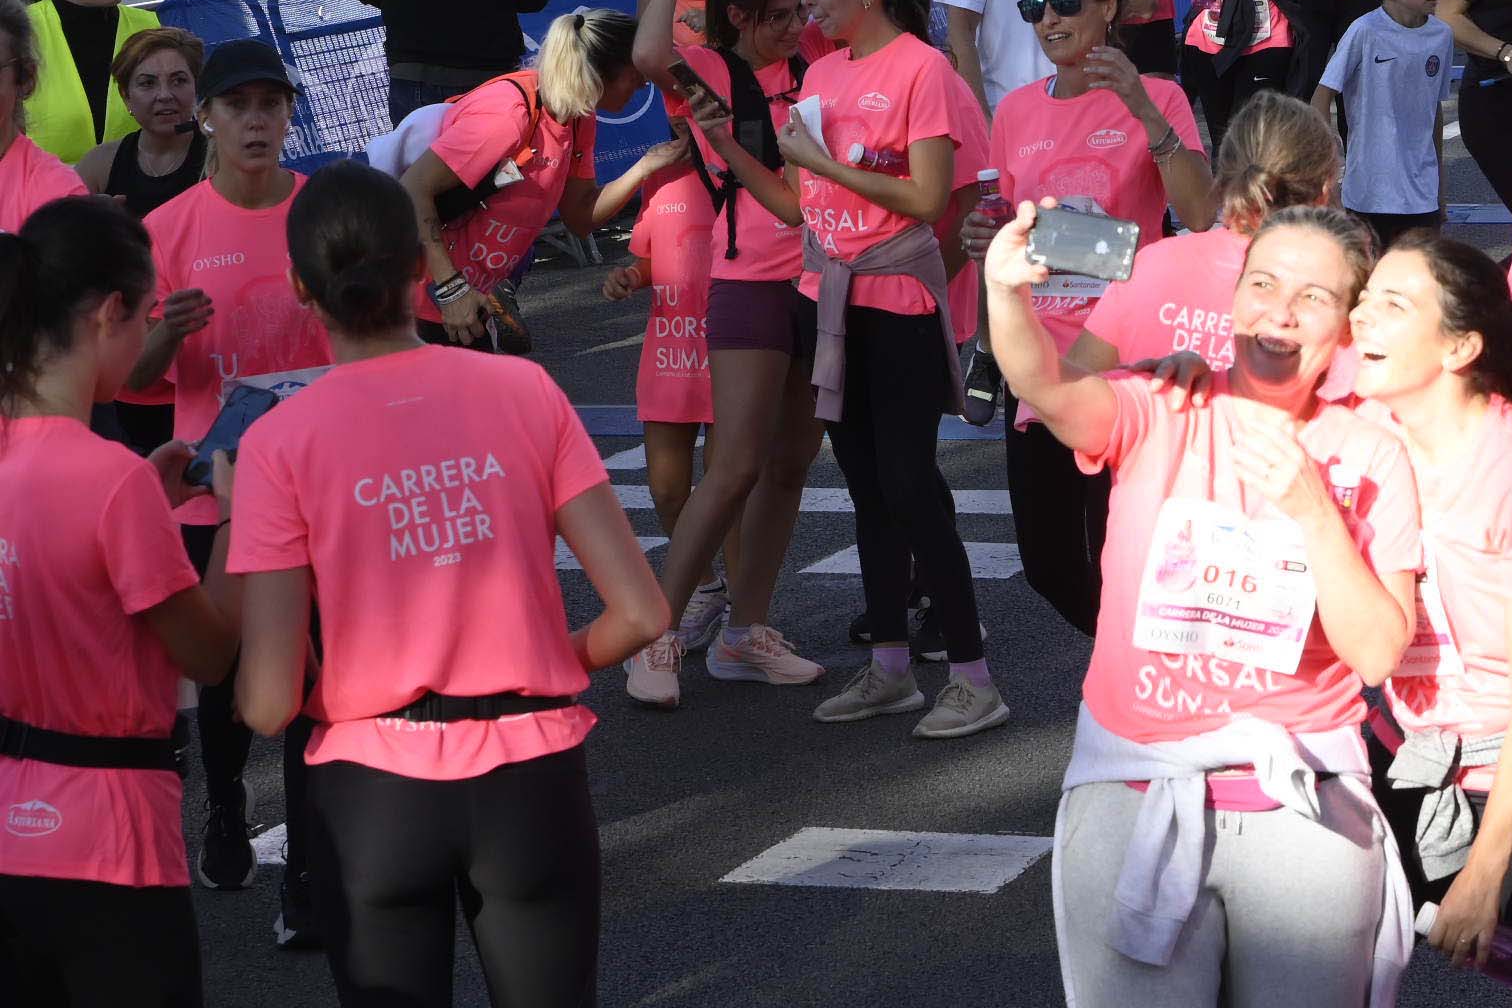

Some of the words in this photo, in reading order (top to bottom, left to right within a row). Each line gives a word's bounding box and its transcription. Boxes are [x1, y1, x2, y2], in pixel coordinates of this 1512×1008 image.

[485, 219, 520, 245] TU
[192, 253, 245, 271] OYSHO
[655, 286, 678, 307] TU
[1069, 280, 1101, 290] Santander
[1208, 334, 1235, 359] LA
[354, 453, 506, 508] CARRERA
[387, 498, 430, 530] DE
[441, 488, 484, 518] LA
[389, 514, 494, 561] MUJER
[433, 551, 462, 568] 2023
[1203, 565, 1257, 594] 016
[1231, 614, 1265, 632] MUJER
[1149, 627, 1199, 644] OYSHO
